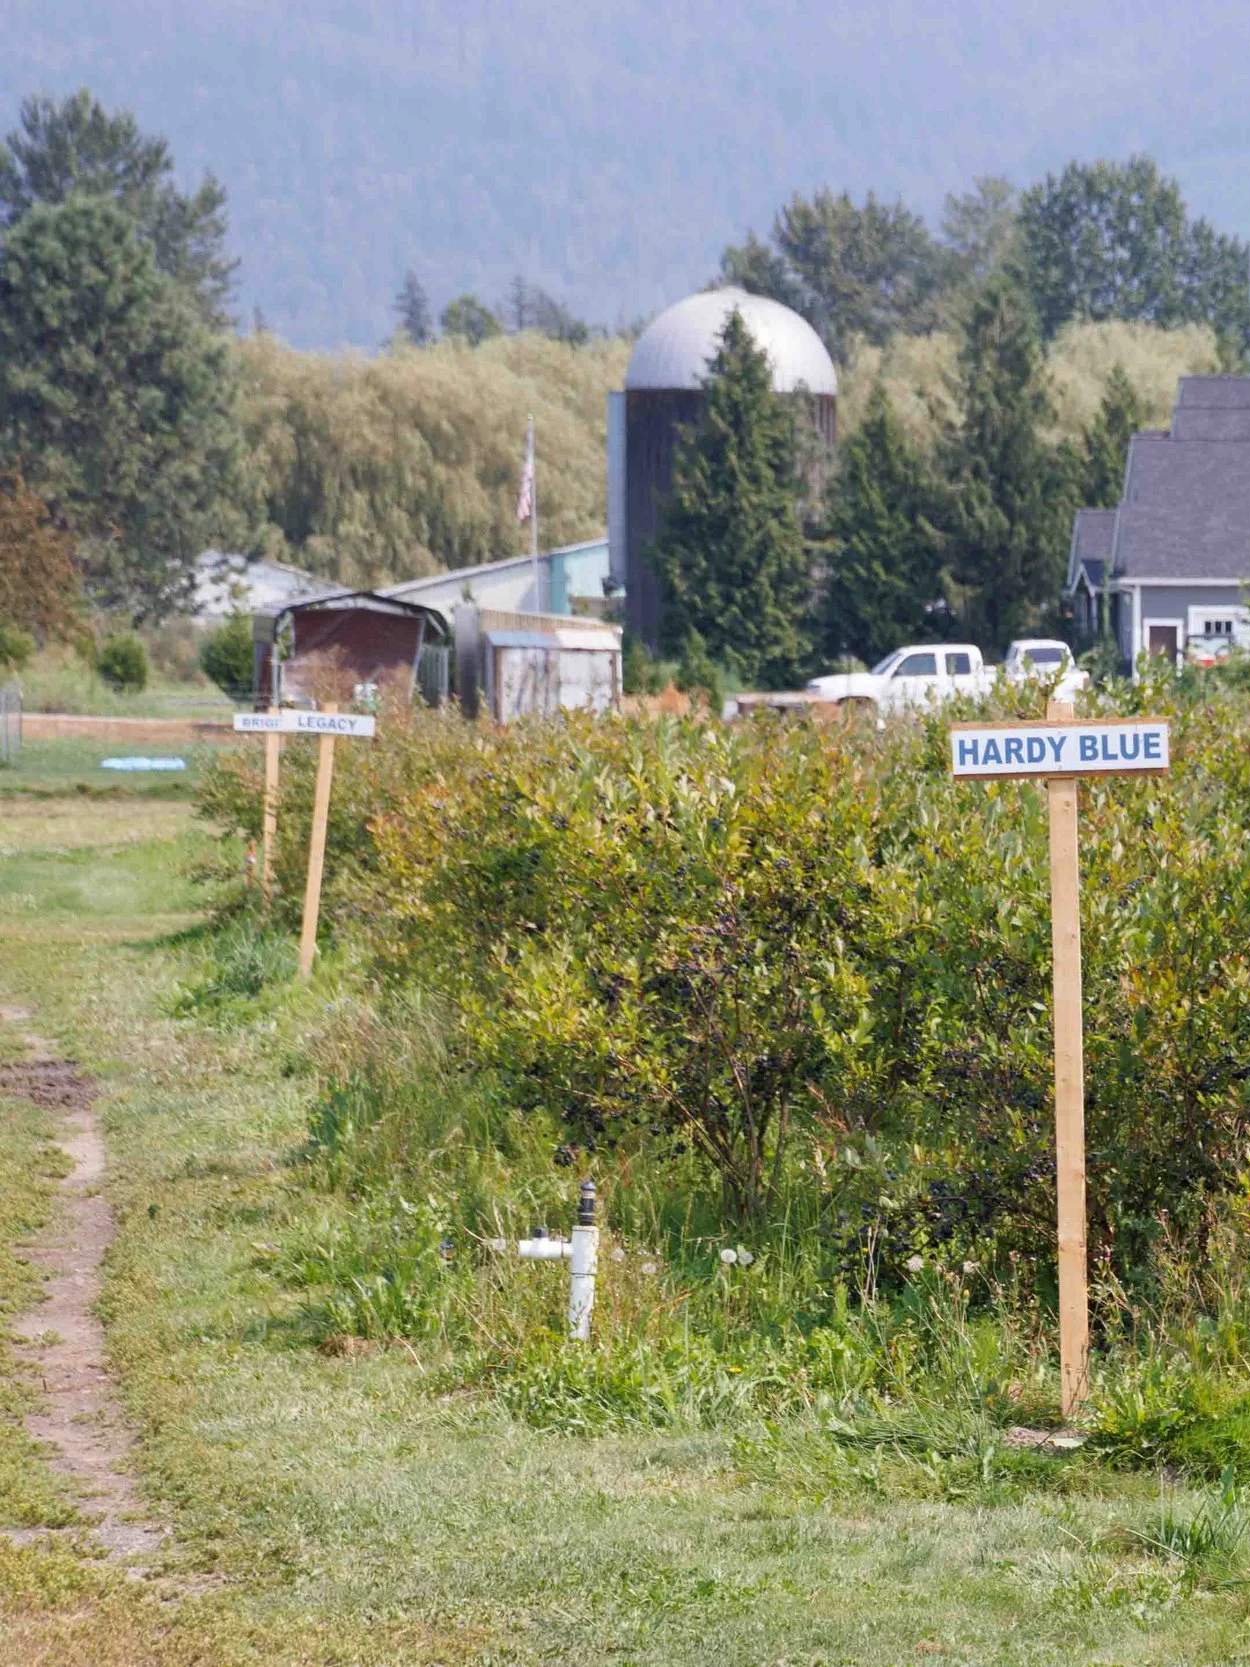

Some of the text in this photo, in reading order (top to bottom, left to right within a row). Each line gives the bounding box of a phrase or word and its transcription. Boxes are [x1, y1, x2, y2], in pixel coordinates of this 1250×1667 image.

[297, 714, 358, 731] LEGACY
[958, 732, 1161, 766] HARDY BLUE
